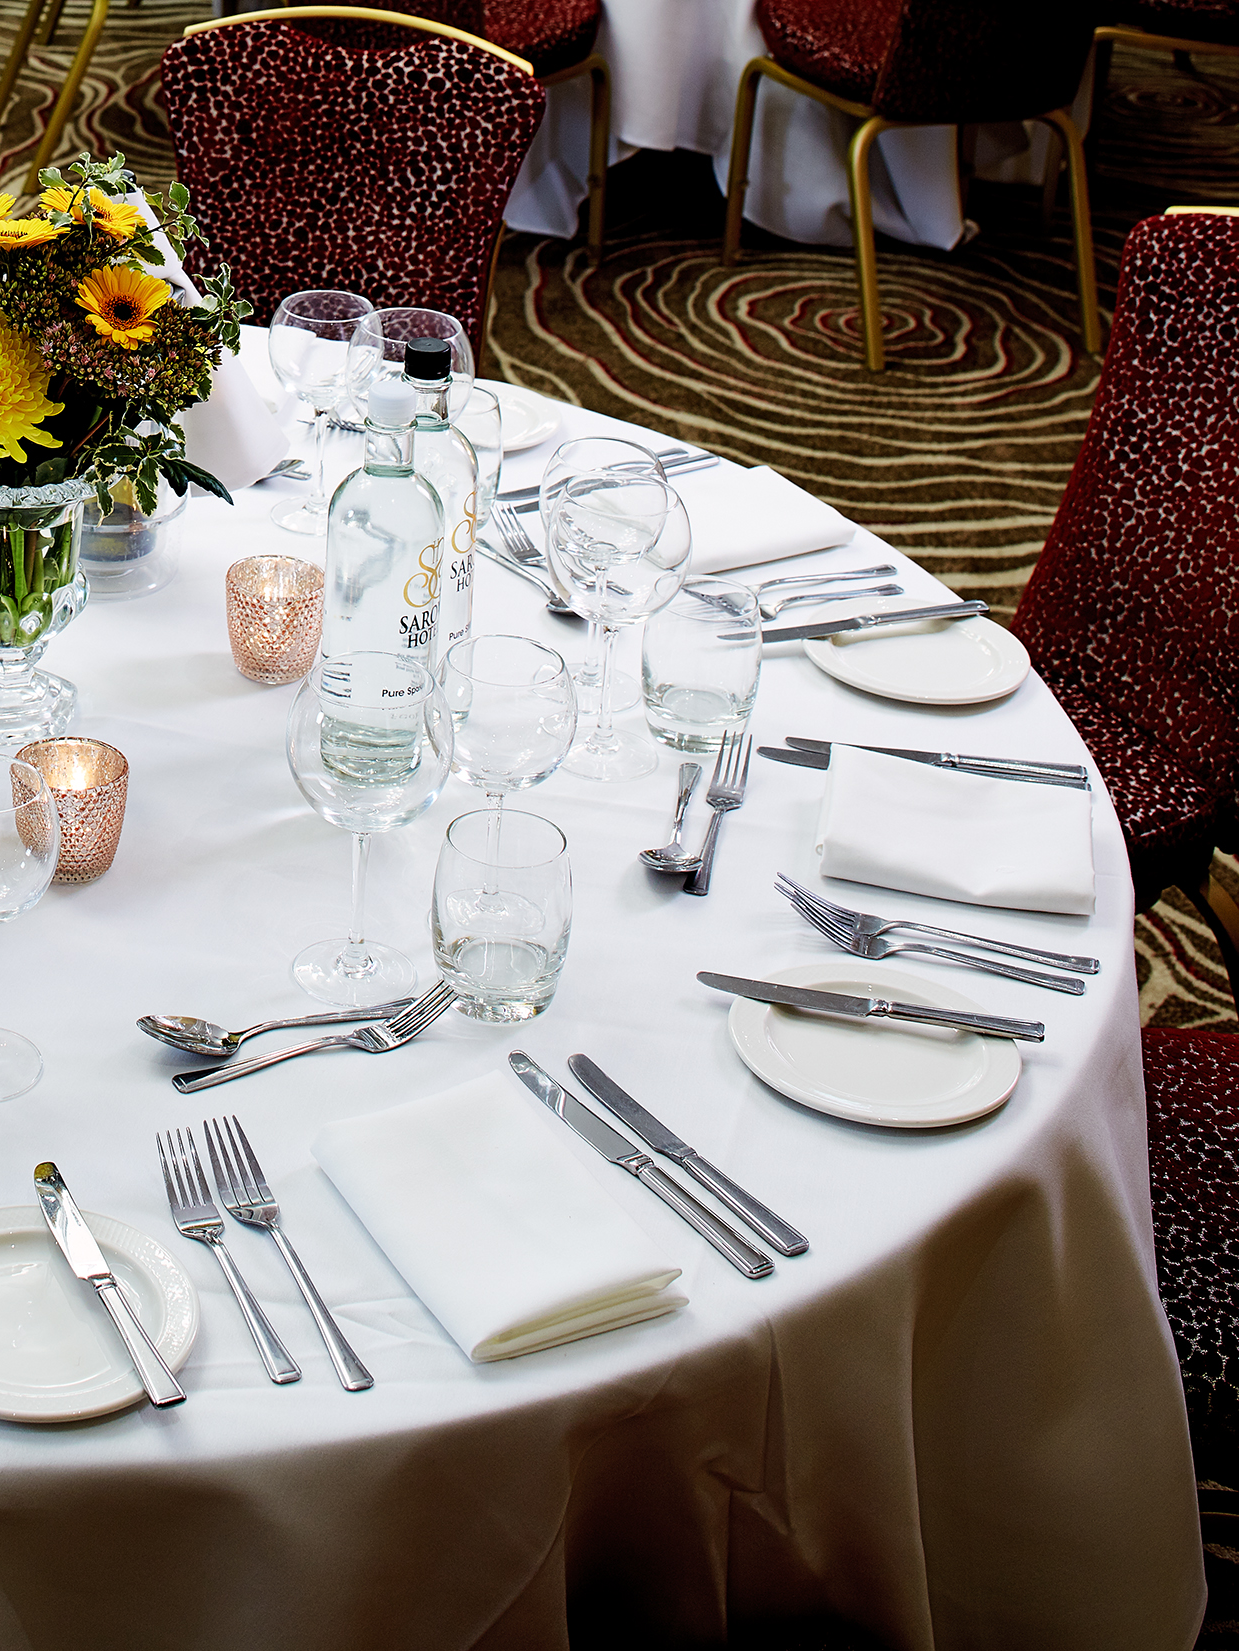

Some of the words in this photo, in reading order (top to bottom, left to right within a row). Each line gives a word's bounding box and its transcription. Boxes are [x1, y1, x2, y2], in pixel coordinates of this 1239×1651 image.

[450, 554, 475, 580] SAR
[399, 603, 440, 635] SARO
[448, 628, 465, 641] Pure
[381, 688, 405, 698] Pure
